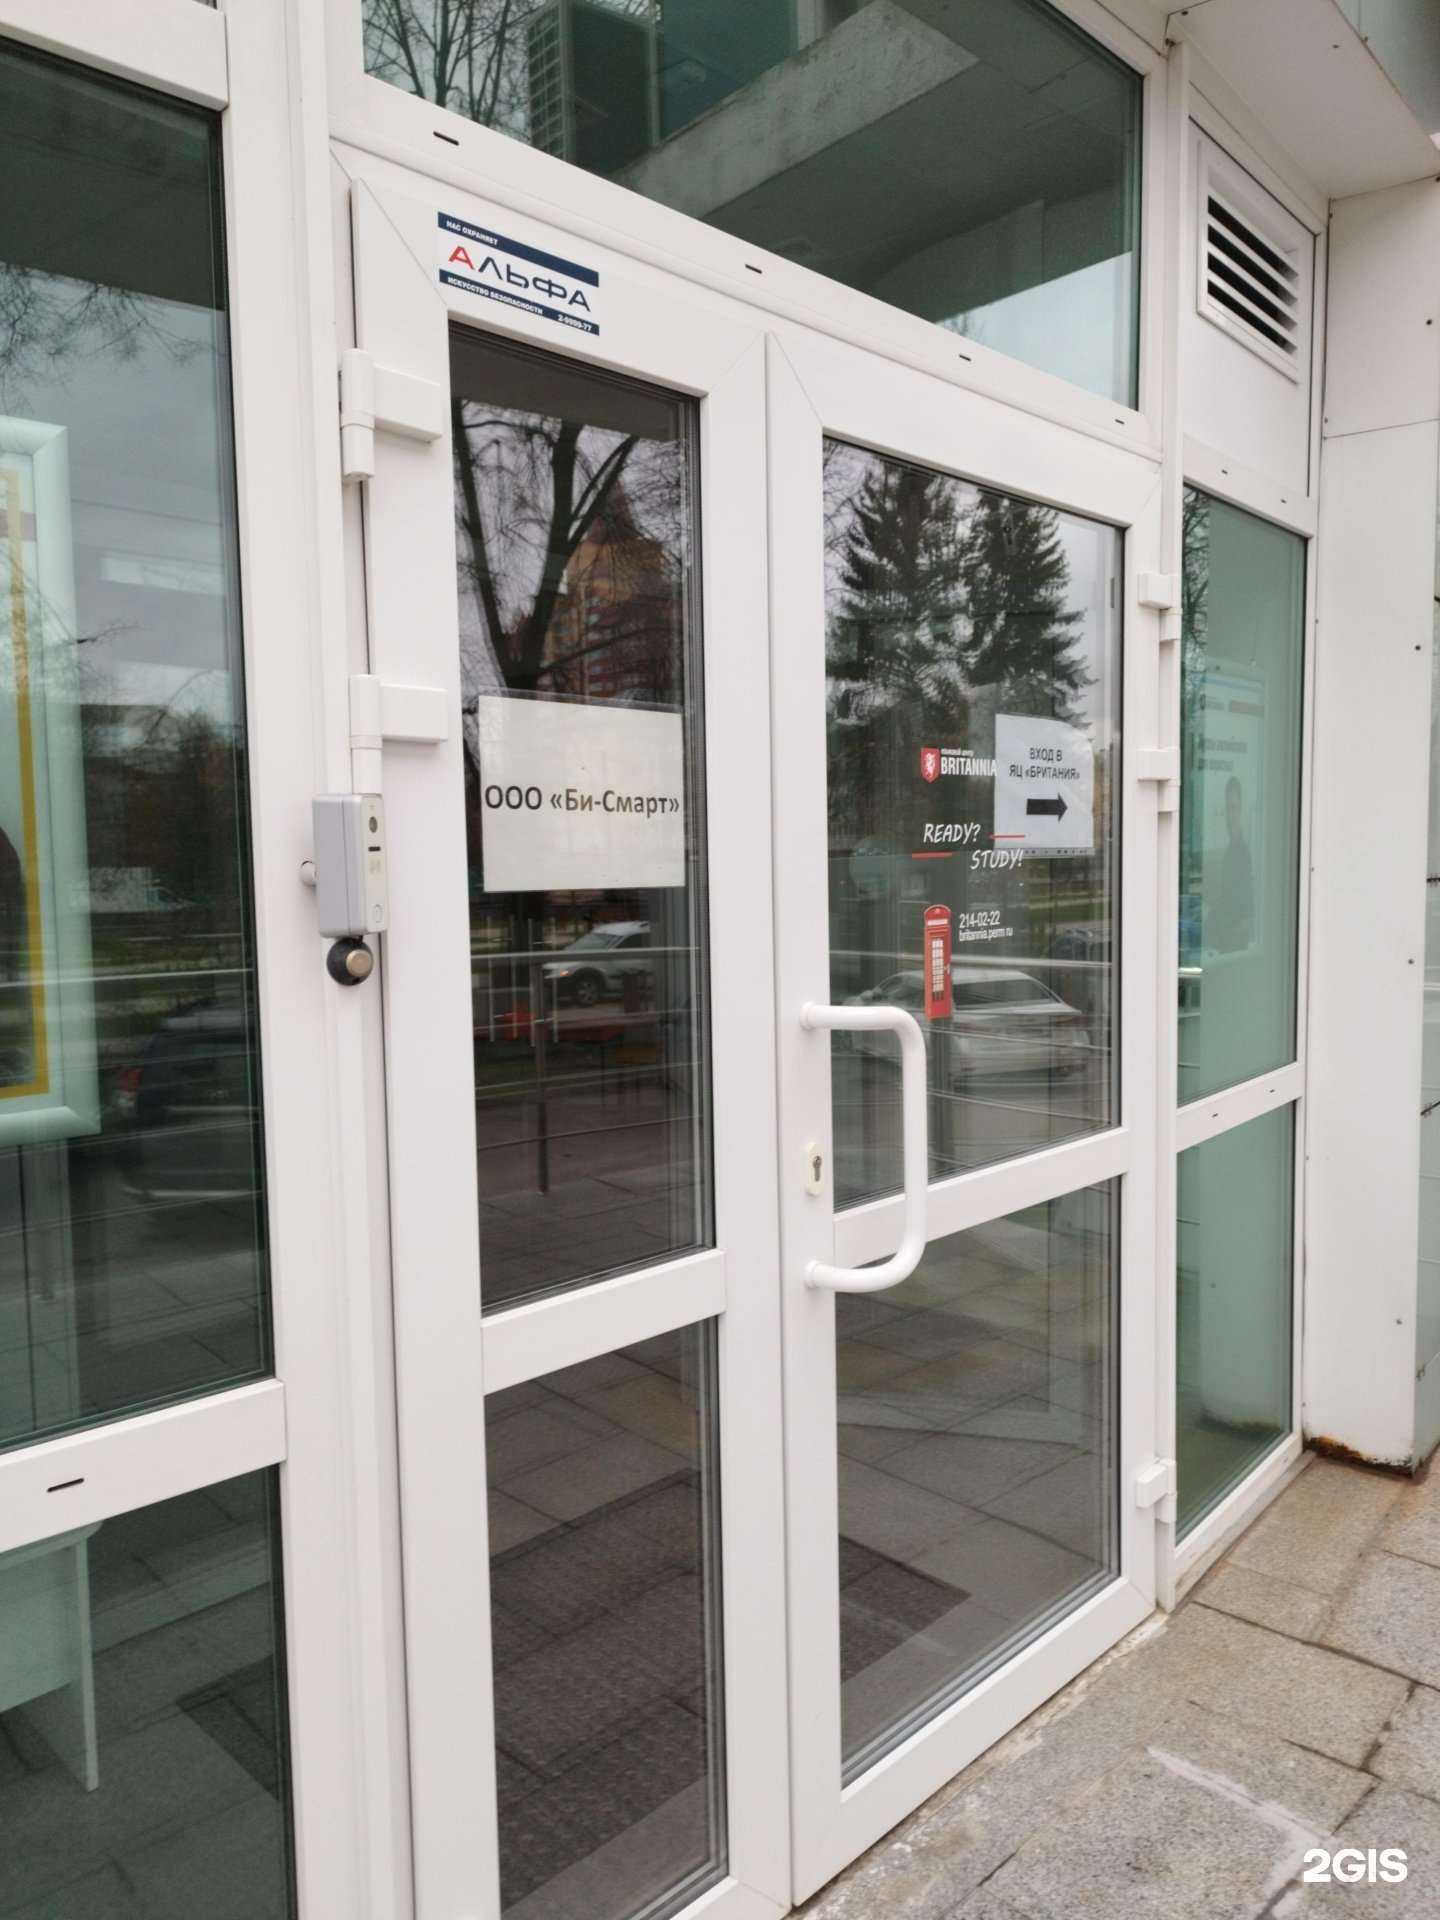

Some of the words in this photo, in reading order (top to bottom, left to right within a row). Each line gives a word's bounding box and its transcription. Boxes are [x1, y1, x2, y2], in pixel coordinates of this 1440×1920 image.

[448, 245, 591, 312] АЛЬФА
[1029, 747, 1054, 762] ВХОД
[1056, 749, 1063, 762] В
[940, 756, 997, 776] BRITANNIA
[1009, 764, 1023, 780] ЯЦ
[484, 784, 543, 810] ООО
[550, 788, 680, 818] «Би-Смарт»
[923, 822, 981, 844] READY?
[970, 848, 1024, 870] STUDY!
[959, 910, 1001, 929] 214-02-22
